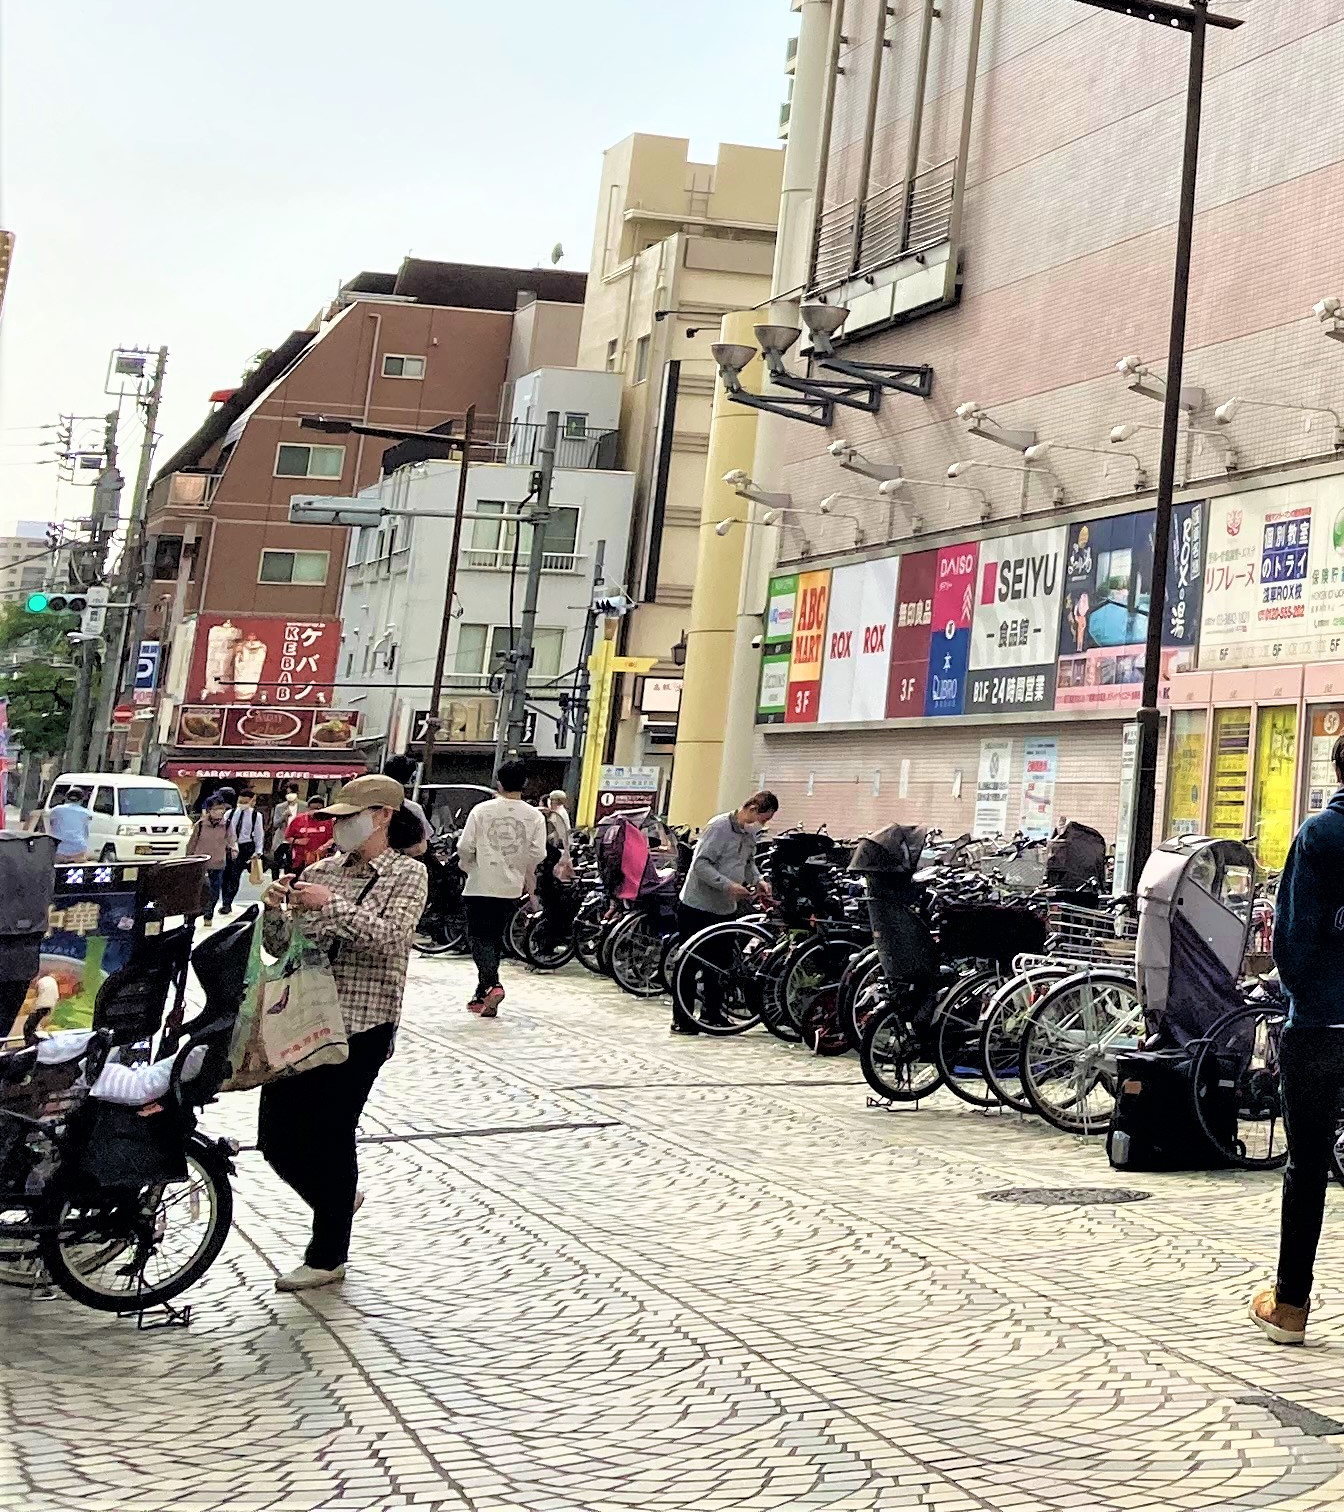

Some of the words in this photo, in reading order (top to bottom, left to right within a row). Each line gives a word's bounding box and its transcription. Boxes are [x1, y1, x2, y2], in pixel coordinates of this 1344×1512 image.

[940, 554, 974, 578] DAISO
[998, 552, 1058, 603] SEIYU
[1206, 563, 1255, 594] リフレーヌ
[1262, 551, 1307, 579] のトライ
[797, 586, 826, 631] ABC
[794, 634, 822, 664] MART
[830, 630, 853, 660] ROX
[863, 624, 887, 654] ROX
[1272, 643, 1283, 657] 5F
[1329, 638, 1341, 652] 5F
[276, 627, 299, 701] KEBAB
[795, 691, 810, 714] 3F
[900, 678, 916, 702] 3F
[991, 674, 1046, 704] 24時間営業
[196, 770, 231, 779] SARAY
